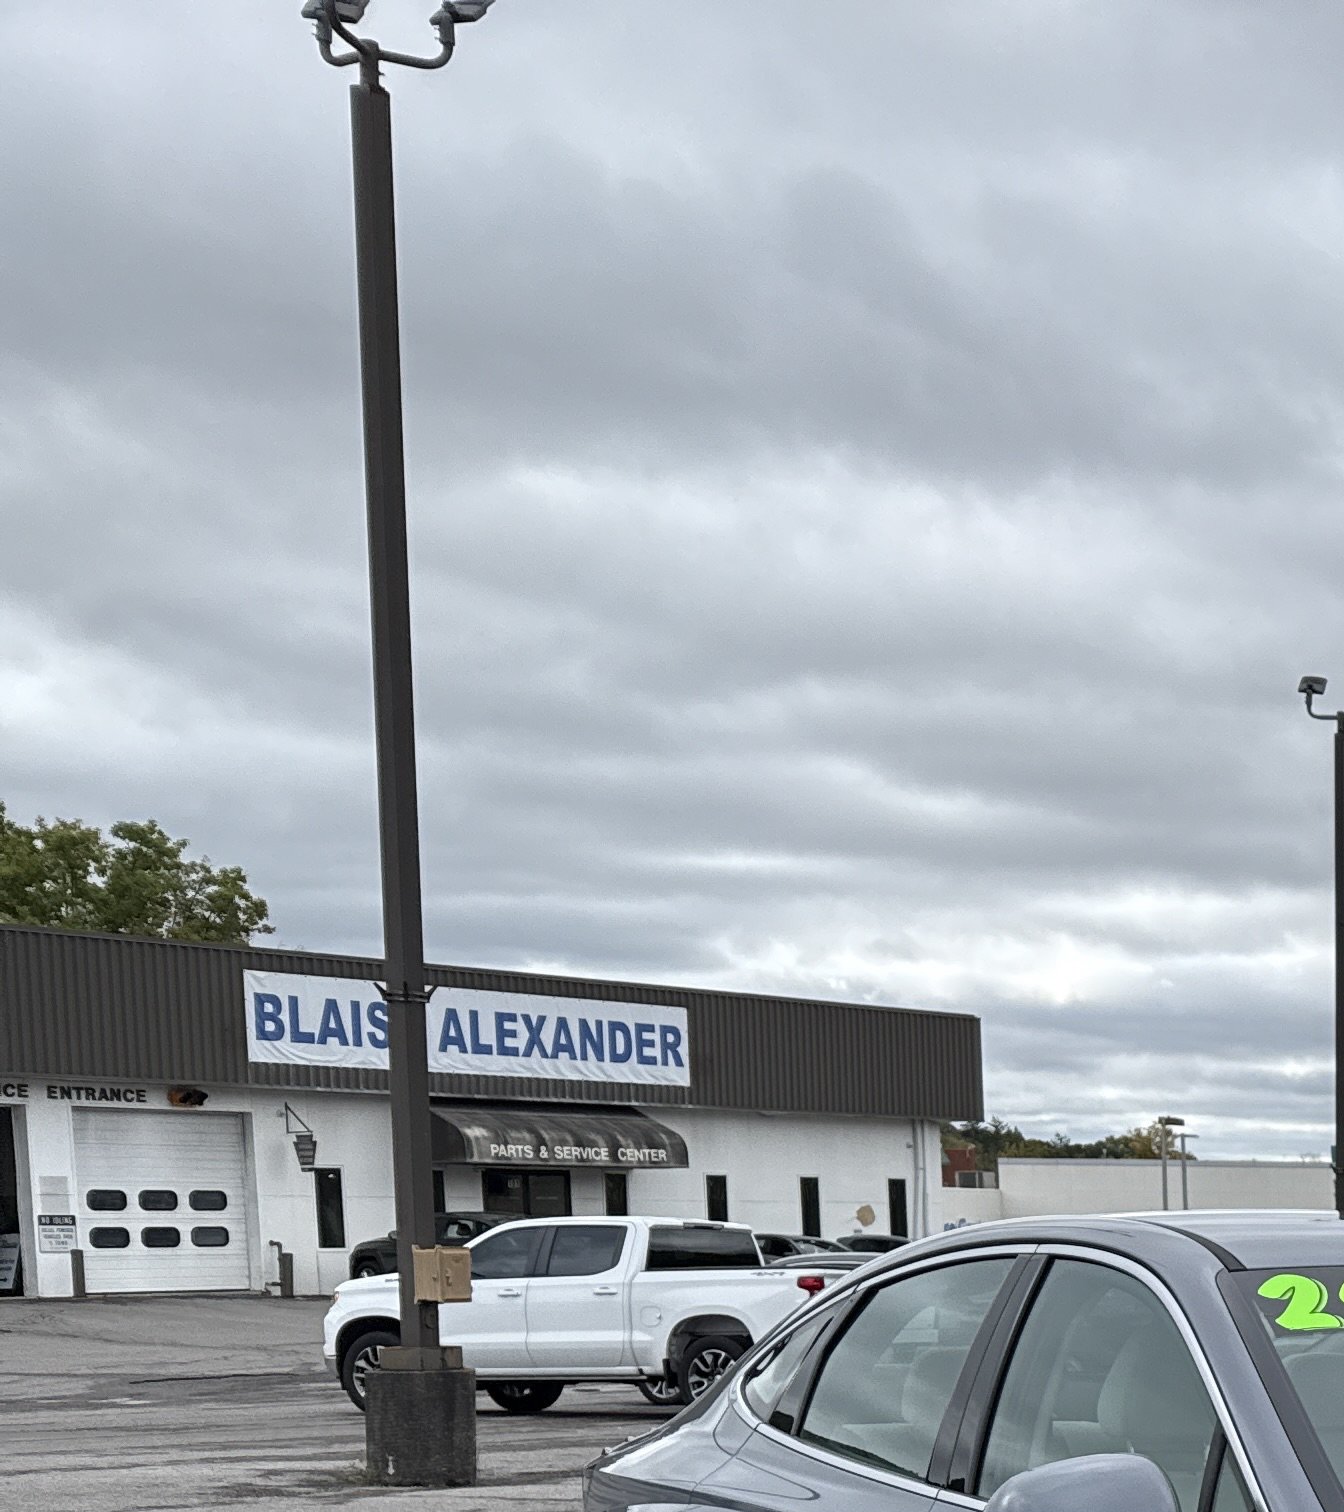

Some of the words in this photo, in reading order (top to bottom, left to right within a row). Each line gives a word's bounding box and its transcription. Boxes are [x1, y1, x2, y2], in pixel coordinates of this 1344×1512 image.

[252, 991, 392, 1050] BLAIS
[438, 1007, 685, 1068] ALEXANDER
[0, 1083, 29, 1098] CE
[46, 1085, 147, 1103] ENTRANCE
[490, 1143, 534, 1159] PARTS
[540, 1146, 549, 1159] &
[554, 1146, 610, 1161] SERVICE
[617, 1148, 667, 1162] CENTER
